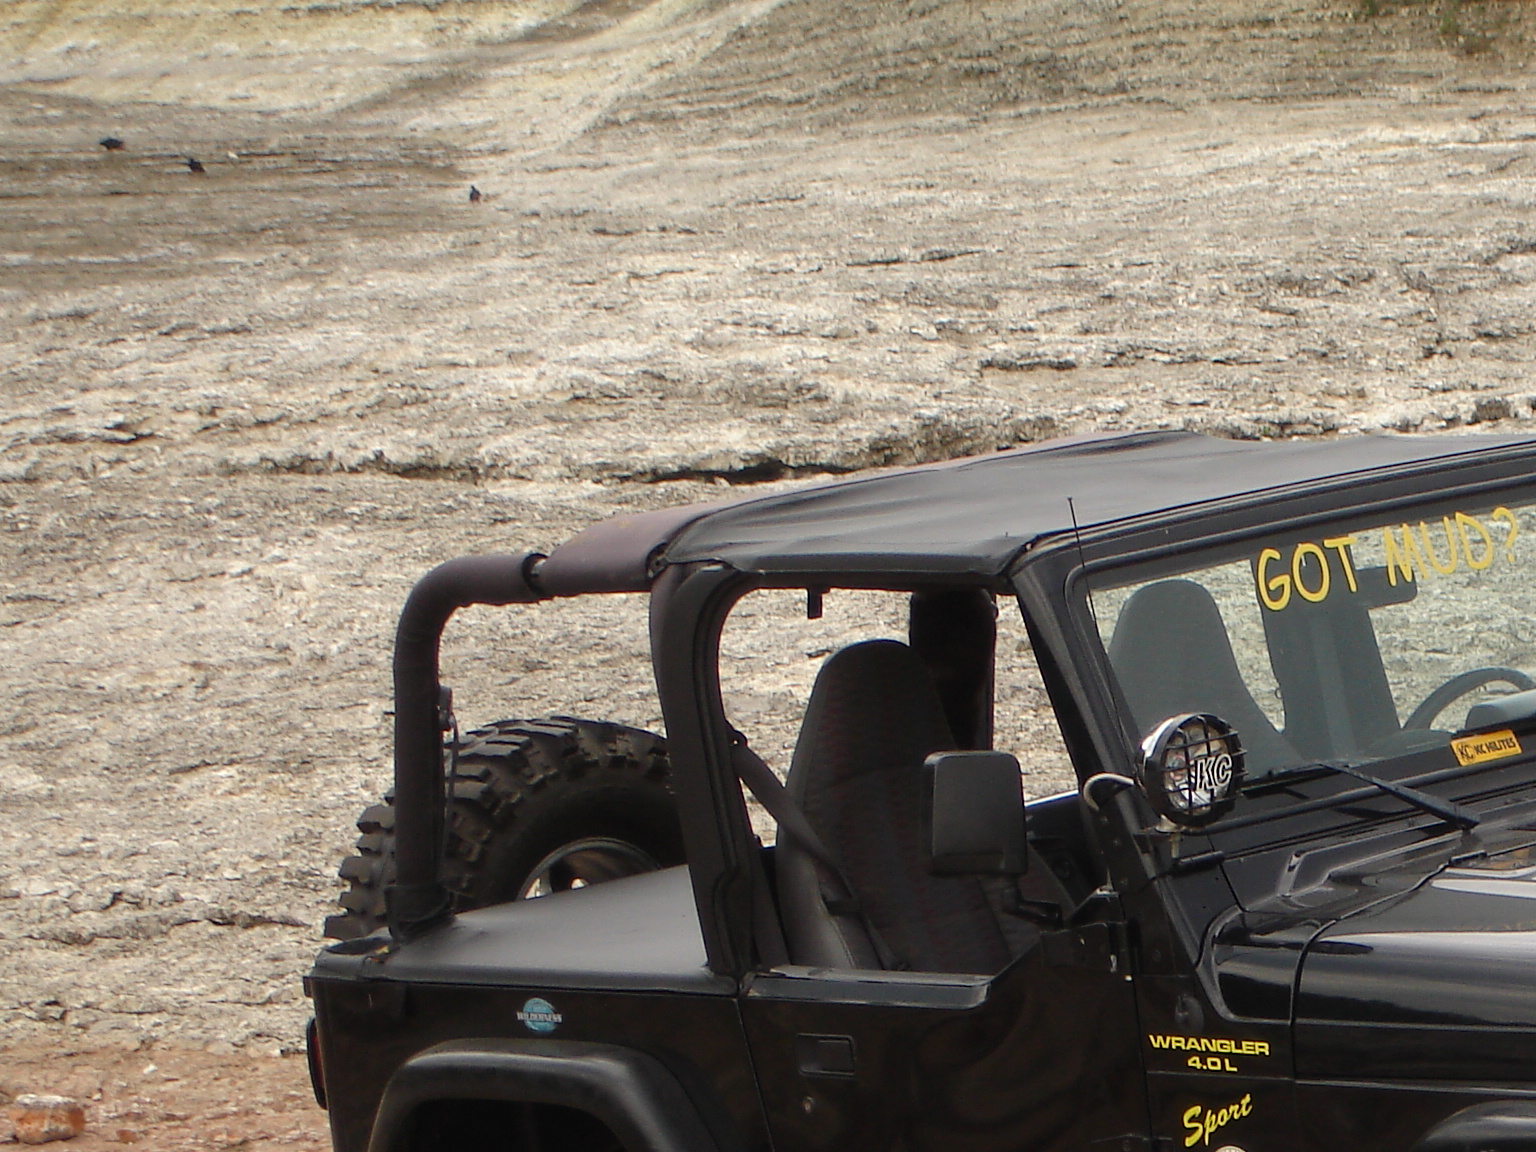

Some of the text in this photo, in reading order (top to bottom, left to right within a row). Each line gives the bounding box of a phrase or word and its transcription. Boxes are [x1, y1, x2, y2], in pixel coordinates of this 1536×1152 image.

[1257, 507, 1518, 611] GOT MUD?
[1196, 753, 1232, 791] KC
[1149, 1034, 1270, 1056] WRANGLER
[1182, 1093, 1254, 1148] Sport
